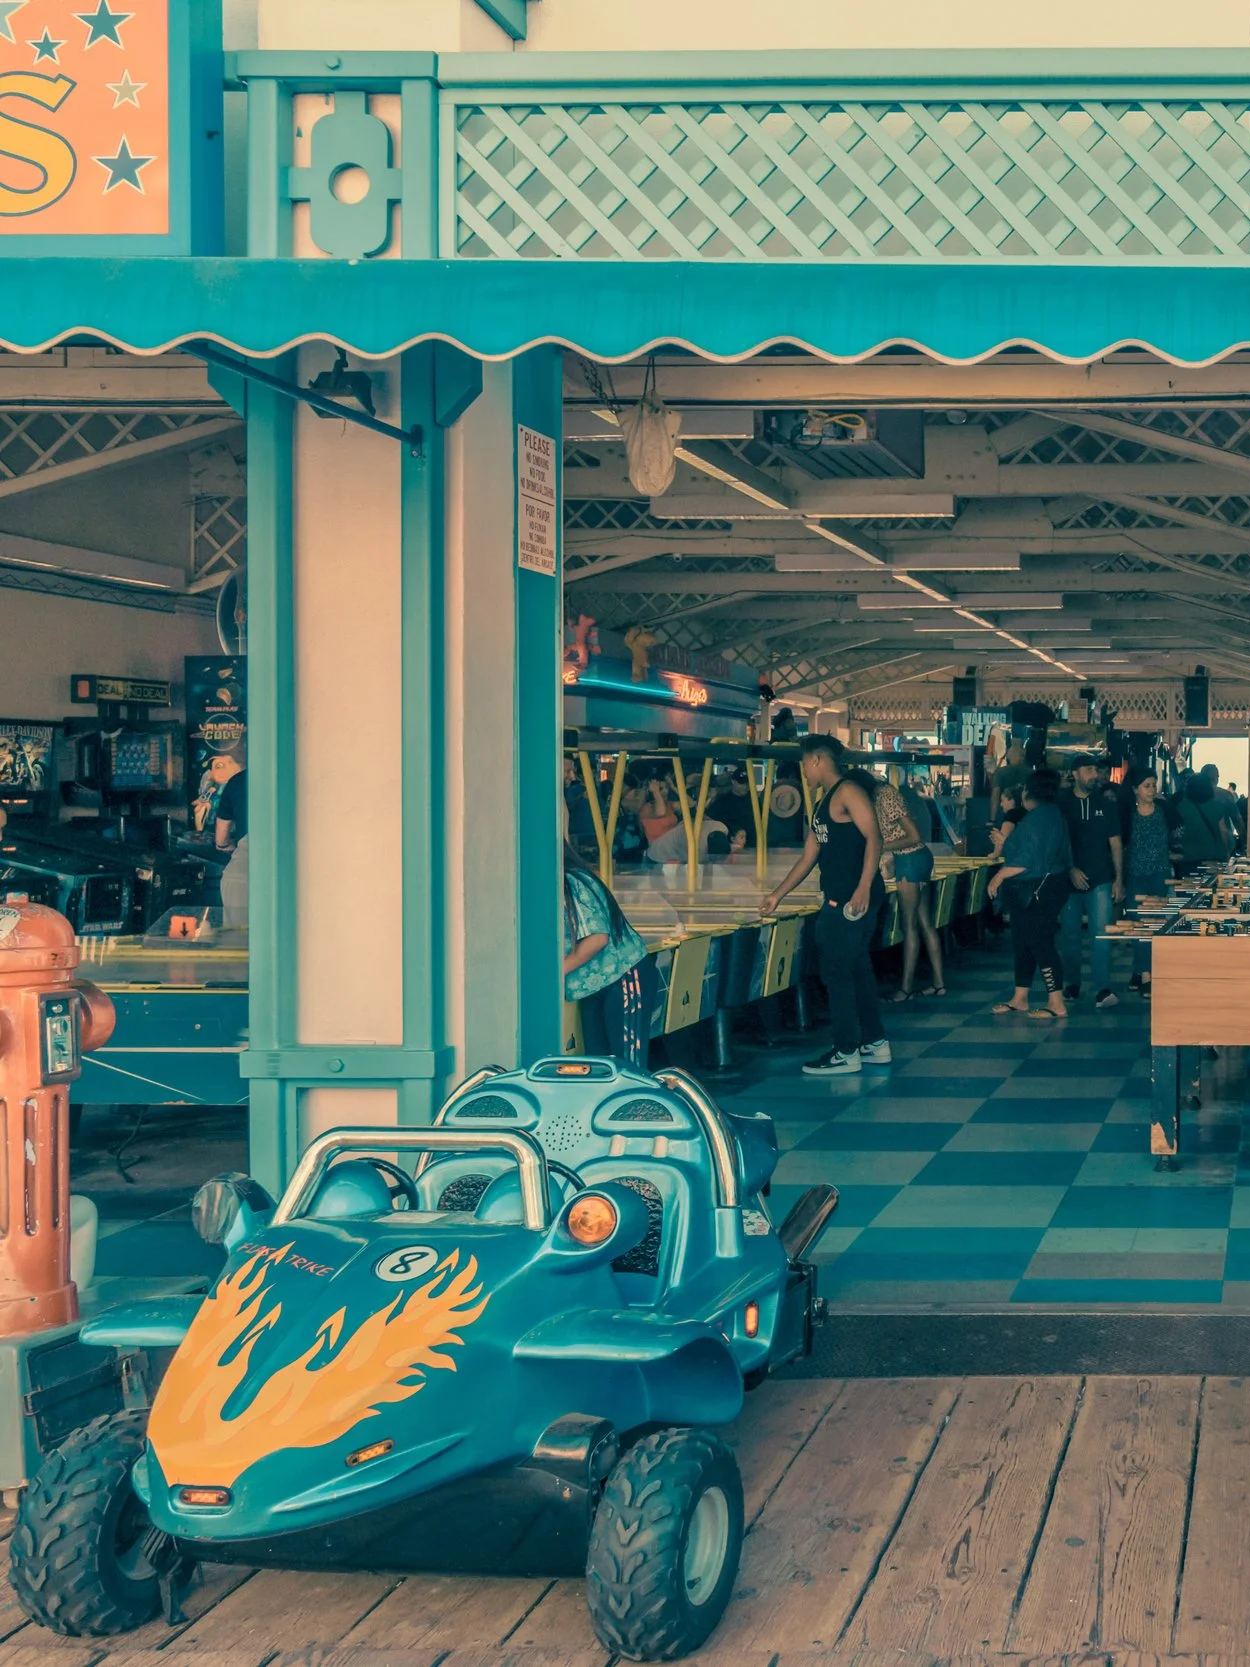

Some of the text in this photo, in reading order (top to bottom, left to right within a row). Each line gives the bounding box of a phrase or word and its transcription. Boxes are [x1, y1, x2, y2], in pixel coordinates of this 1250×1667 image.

[525, 431, 550, 456] PLEASE
[525, 503, 551, 523] POR FAVOR
[97, 682, 122, 696] DEAL
[129, 687, 142, 697] NO
[143, 688, 167, 698] DEAL
[962, 712, 1007, 726] WALKING
[204, 731, 241, 740] CODE
[389, 1251, 429, 1274] 8
